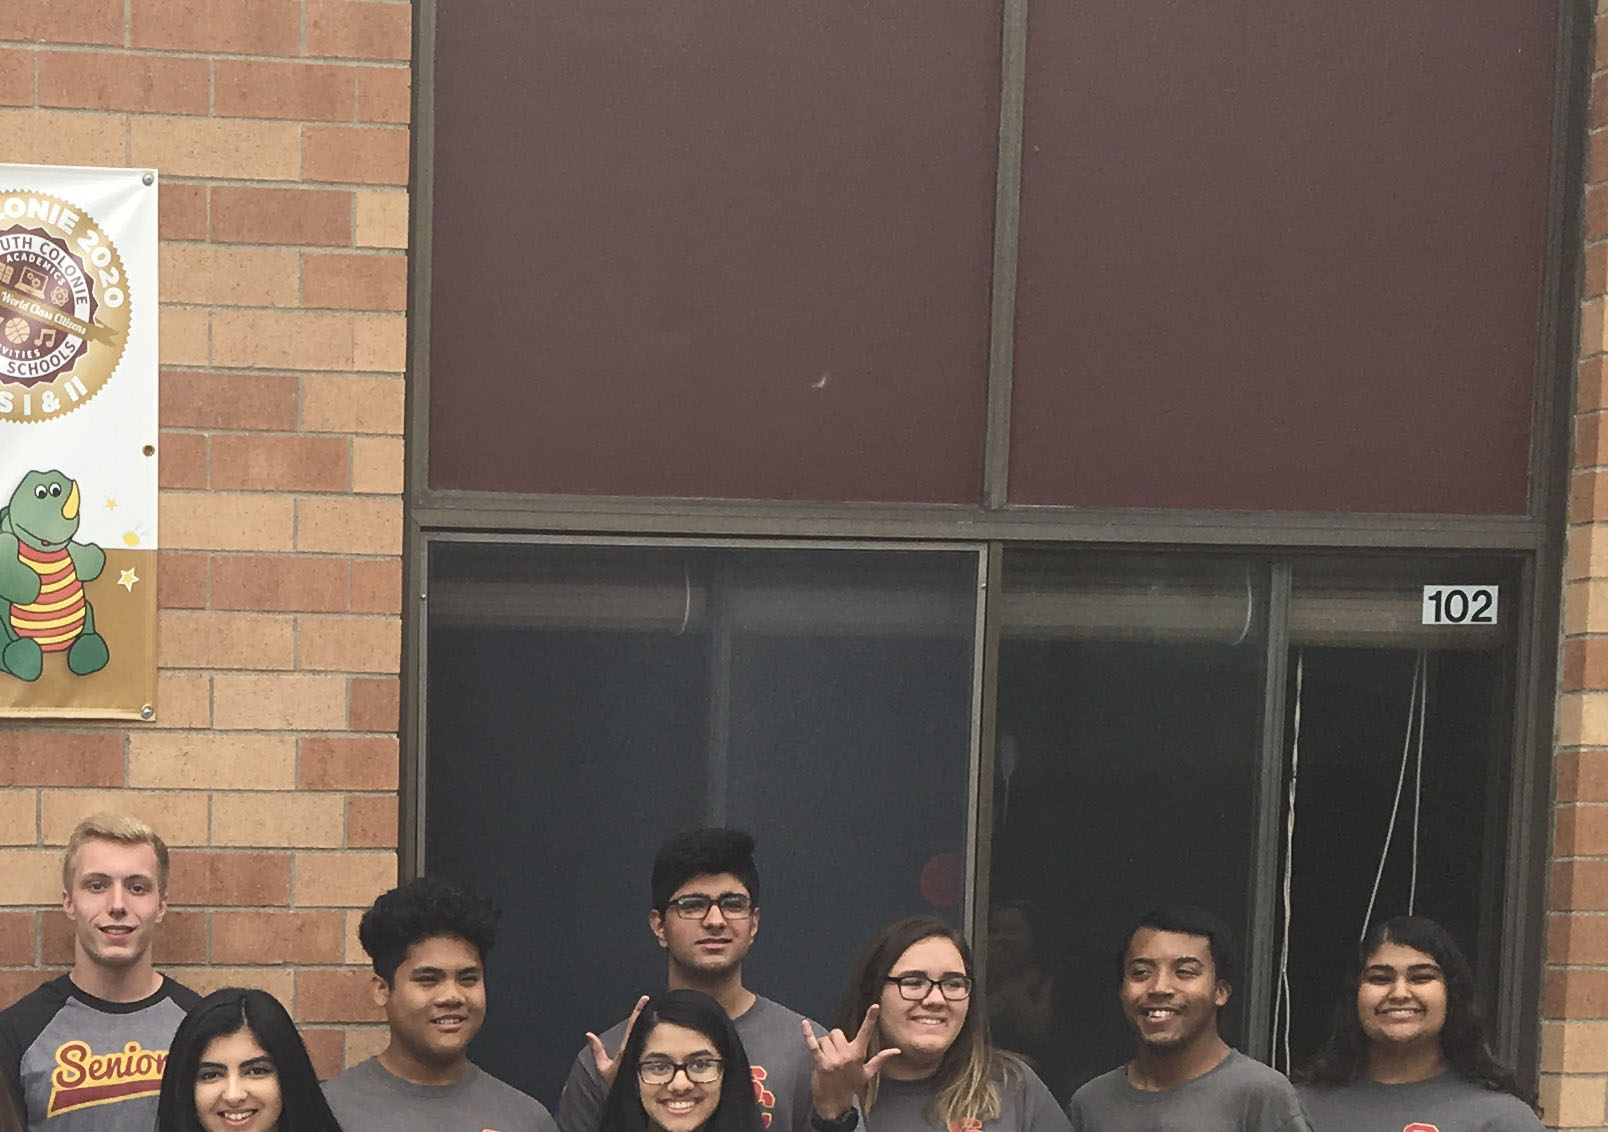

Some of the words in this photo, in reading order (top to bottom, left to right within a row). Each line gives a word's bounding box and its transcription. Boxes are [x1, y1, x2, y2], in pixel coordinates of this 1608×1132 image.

[5, 253, 66, 286] ACADEMICS
[39, 242, 89, 305] COLONIE
[77, 230, 125, 308] 2020
[0, 291, 29, 312] World
[53, 311, 87, 335] Citizens
[6, 340, 77, 376] SCHOOLS
[23, 393, 31, 416] I
[41, 390, 61, 413] &
[63, 376, 88, 403] II
[1428, 589, 1493, 622] 102
[55, 1043, 168, 1089] Senior
